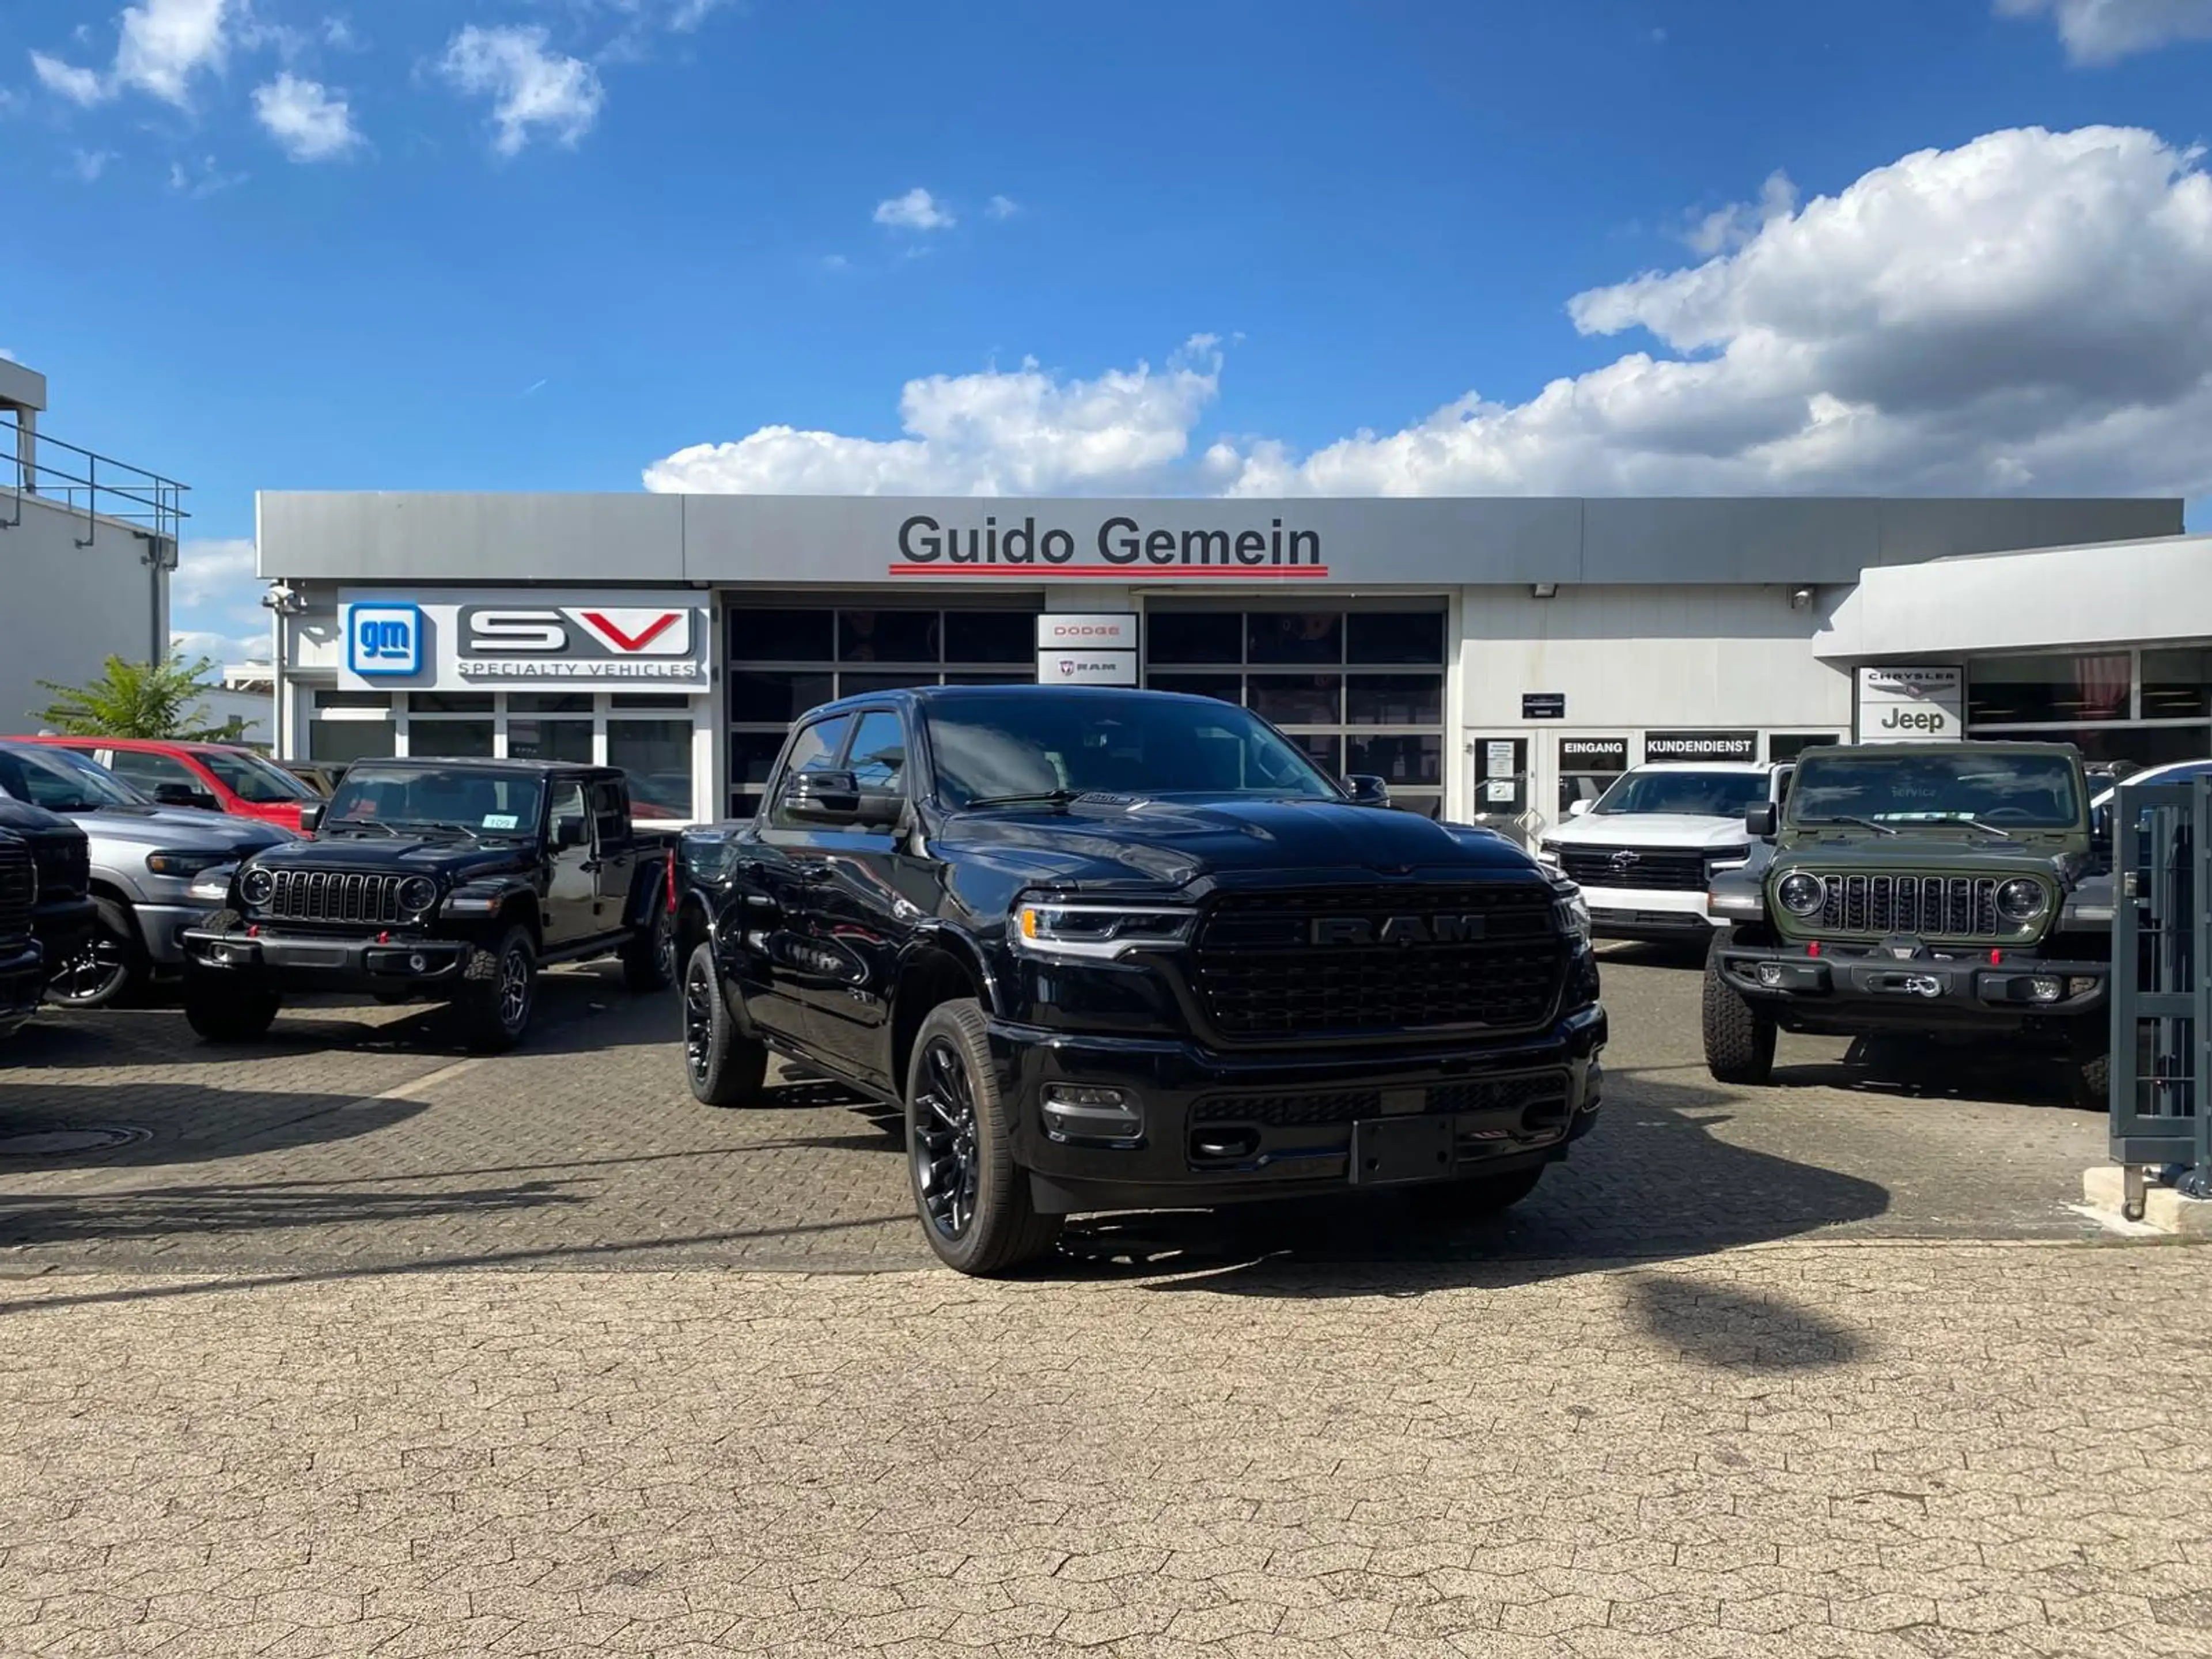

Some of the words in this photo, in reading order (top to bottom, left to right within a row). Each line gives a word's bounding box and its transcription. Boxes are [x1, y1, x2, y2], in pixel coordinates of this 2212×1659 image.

[898, 516, 1075, 564] Guido
[1097, 517, 1320, 565] Gemein
[360, 621, 410, 658] gm
[470, 610, 683, 652] SV
[1054, 626, 1120, 635] DODGE
[459, 663, 577, 675] SPECIALTY
[588, 664, 696, 676] VEHICLES
[1881, 708, 1945, 733] Jeep
[1565, 743, 1623, 753] EINGANG
[1647, 740, 1752, 752] KUNDENDIENST
[1310, 915, 1486, 945] RAM
